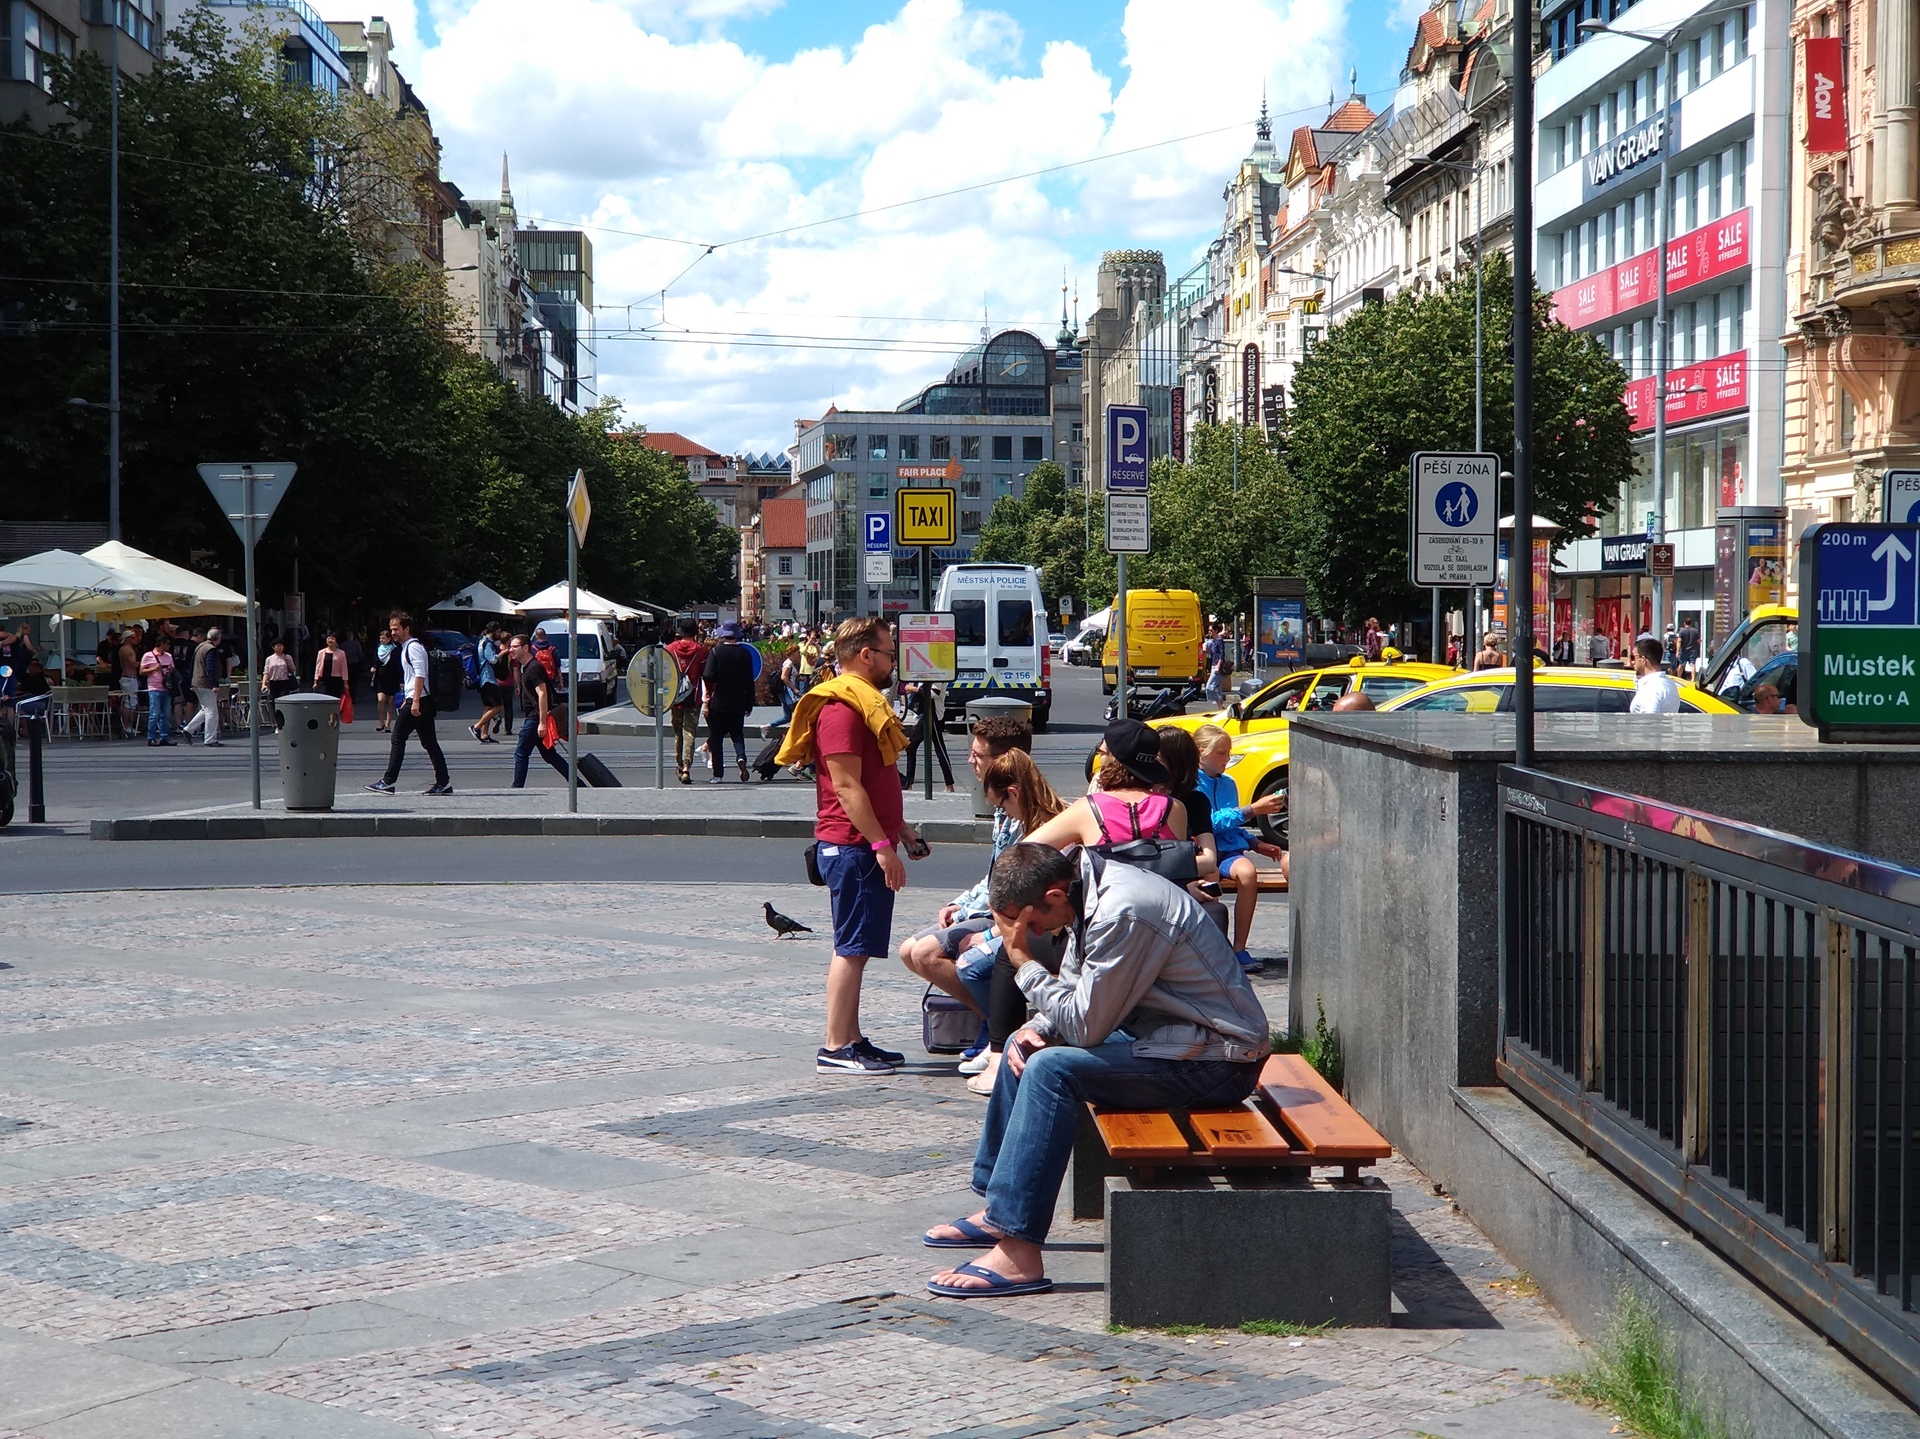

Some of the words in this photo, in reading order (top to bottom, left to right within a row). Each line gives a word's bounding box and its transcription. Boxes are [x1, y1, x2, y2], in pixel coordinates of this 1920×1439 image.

[1814, 72, 1835, 120] AON
[1588, 147, 1615, 186] VAN
[1616, 117, 1665, 171] GRAAF
[1717, 221, 1742, 251] SALE
[1666, 245, 1688, 272] SALE
[1717, 247, 1742, 264] VÝPRODEJ
[1619, 265, 1640, 291] SALE
[1577, 284, 1596, 307] SALE
[1716, 362, 1741, 389] SALE
[1623, 391, 1638, 411] ALE
[1716, 386, 1741, 401] VÝPRODEJ
[1117, 416, 1140, 463] P
[899, 468, 919, 477] FAIR
[920, 468, 947, 477] PLACE
[1112, 469, 1145, 481] RÉSERVÉ
[1423, 460, 1453, 475] PĚŠÍ
[1456, 461, 1490, 475] ZÓNA
[1896, 477, 1920, 491] PĚŠ
[908, 506, 943, 527] TAXI
[869, 516, 886, 541] P
[1822, 533, 1851, 546] 200
[1853, 535, 1867, 546] m
[1603, 544, 1619, 563] VAN
[1619, 542, 1647, 562] GRAAF
[1423, 564, 1446, 572] VOZIDLA
[1456, 564, 1488, 572] SOUHLASEM
[957, 576, 995, 584] MĚSTSKÁ
[996, 576, 1027, 585] POLICIE
[1143, 620, 1183, 628] DHL
[1824, 653, 1916, 676] Můstek
[1016, 671, 1031, 680] 156
[1830, 690, 1885, 706] Metro
[1895, 691, 1910, 705] A
